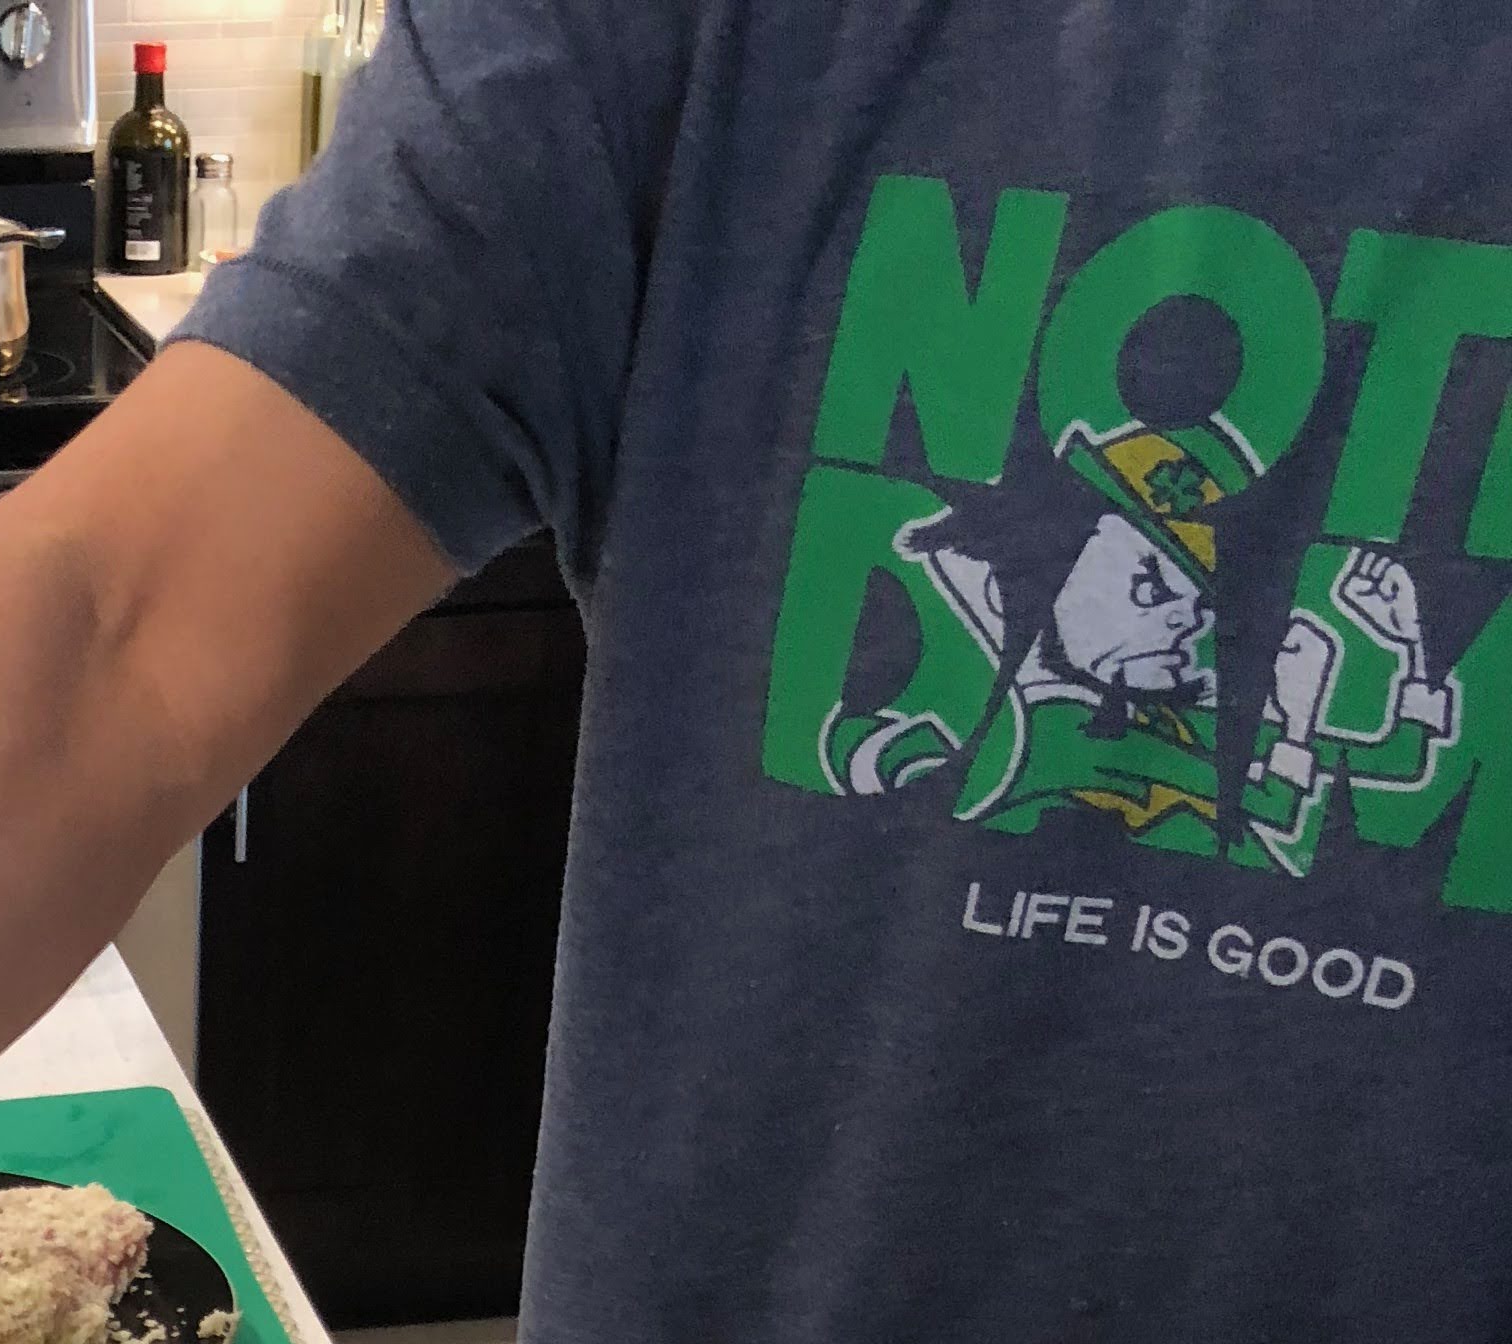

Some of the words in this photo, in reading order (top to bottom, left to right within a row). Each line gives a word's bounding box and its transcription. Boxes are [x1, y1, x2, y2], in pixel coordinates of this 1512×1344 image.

[962, 882, 1113, 946] LIFE
[1130, 904, 1190, 961] IS
[1207, 923, 1416, 1010] GOOD
